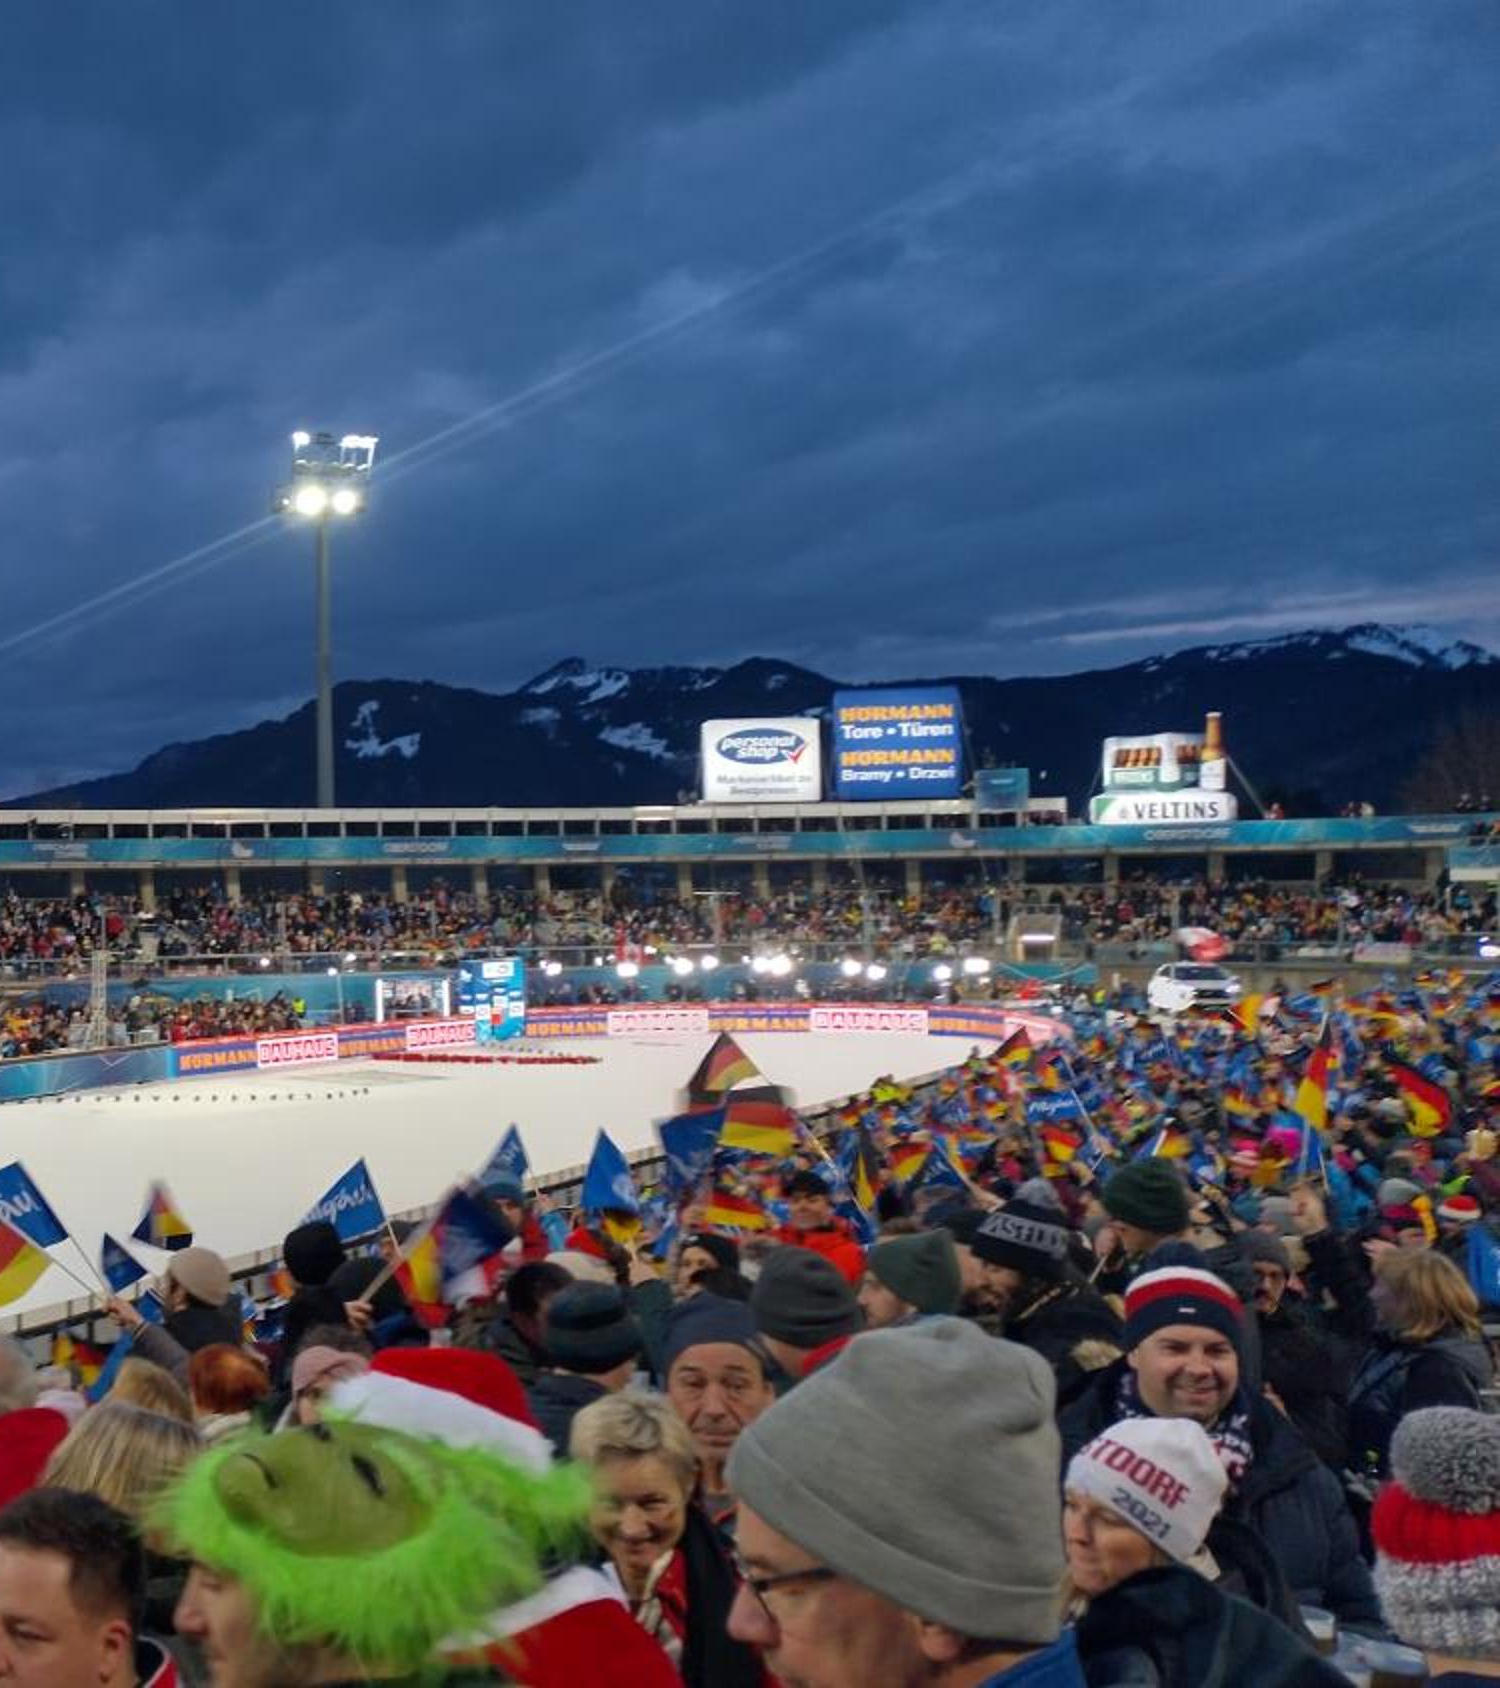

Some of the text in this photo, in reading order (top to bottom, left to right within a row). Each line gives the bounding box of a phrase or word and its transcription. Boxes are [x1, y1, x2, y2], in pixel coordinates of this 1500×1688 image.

[841, 721, 955, 739] Tore Türen
[721, 736, 796, 753] personal
[737, 747, 777, 760] shop
[1134, 801, 1220, 819] VELTINS
[259, 1037, 336, 1064] BAUHAUS
[1111, 1487, 1172, 1540] 2021
